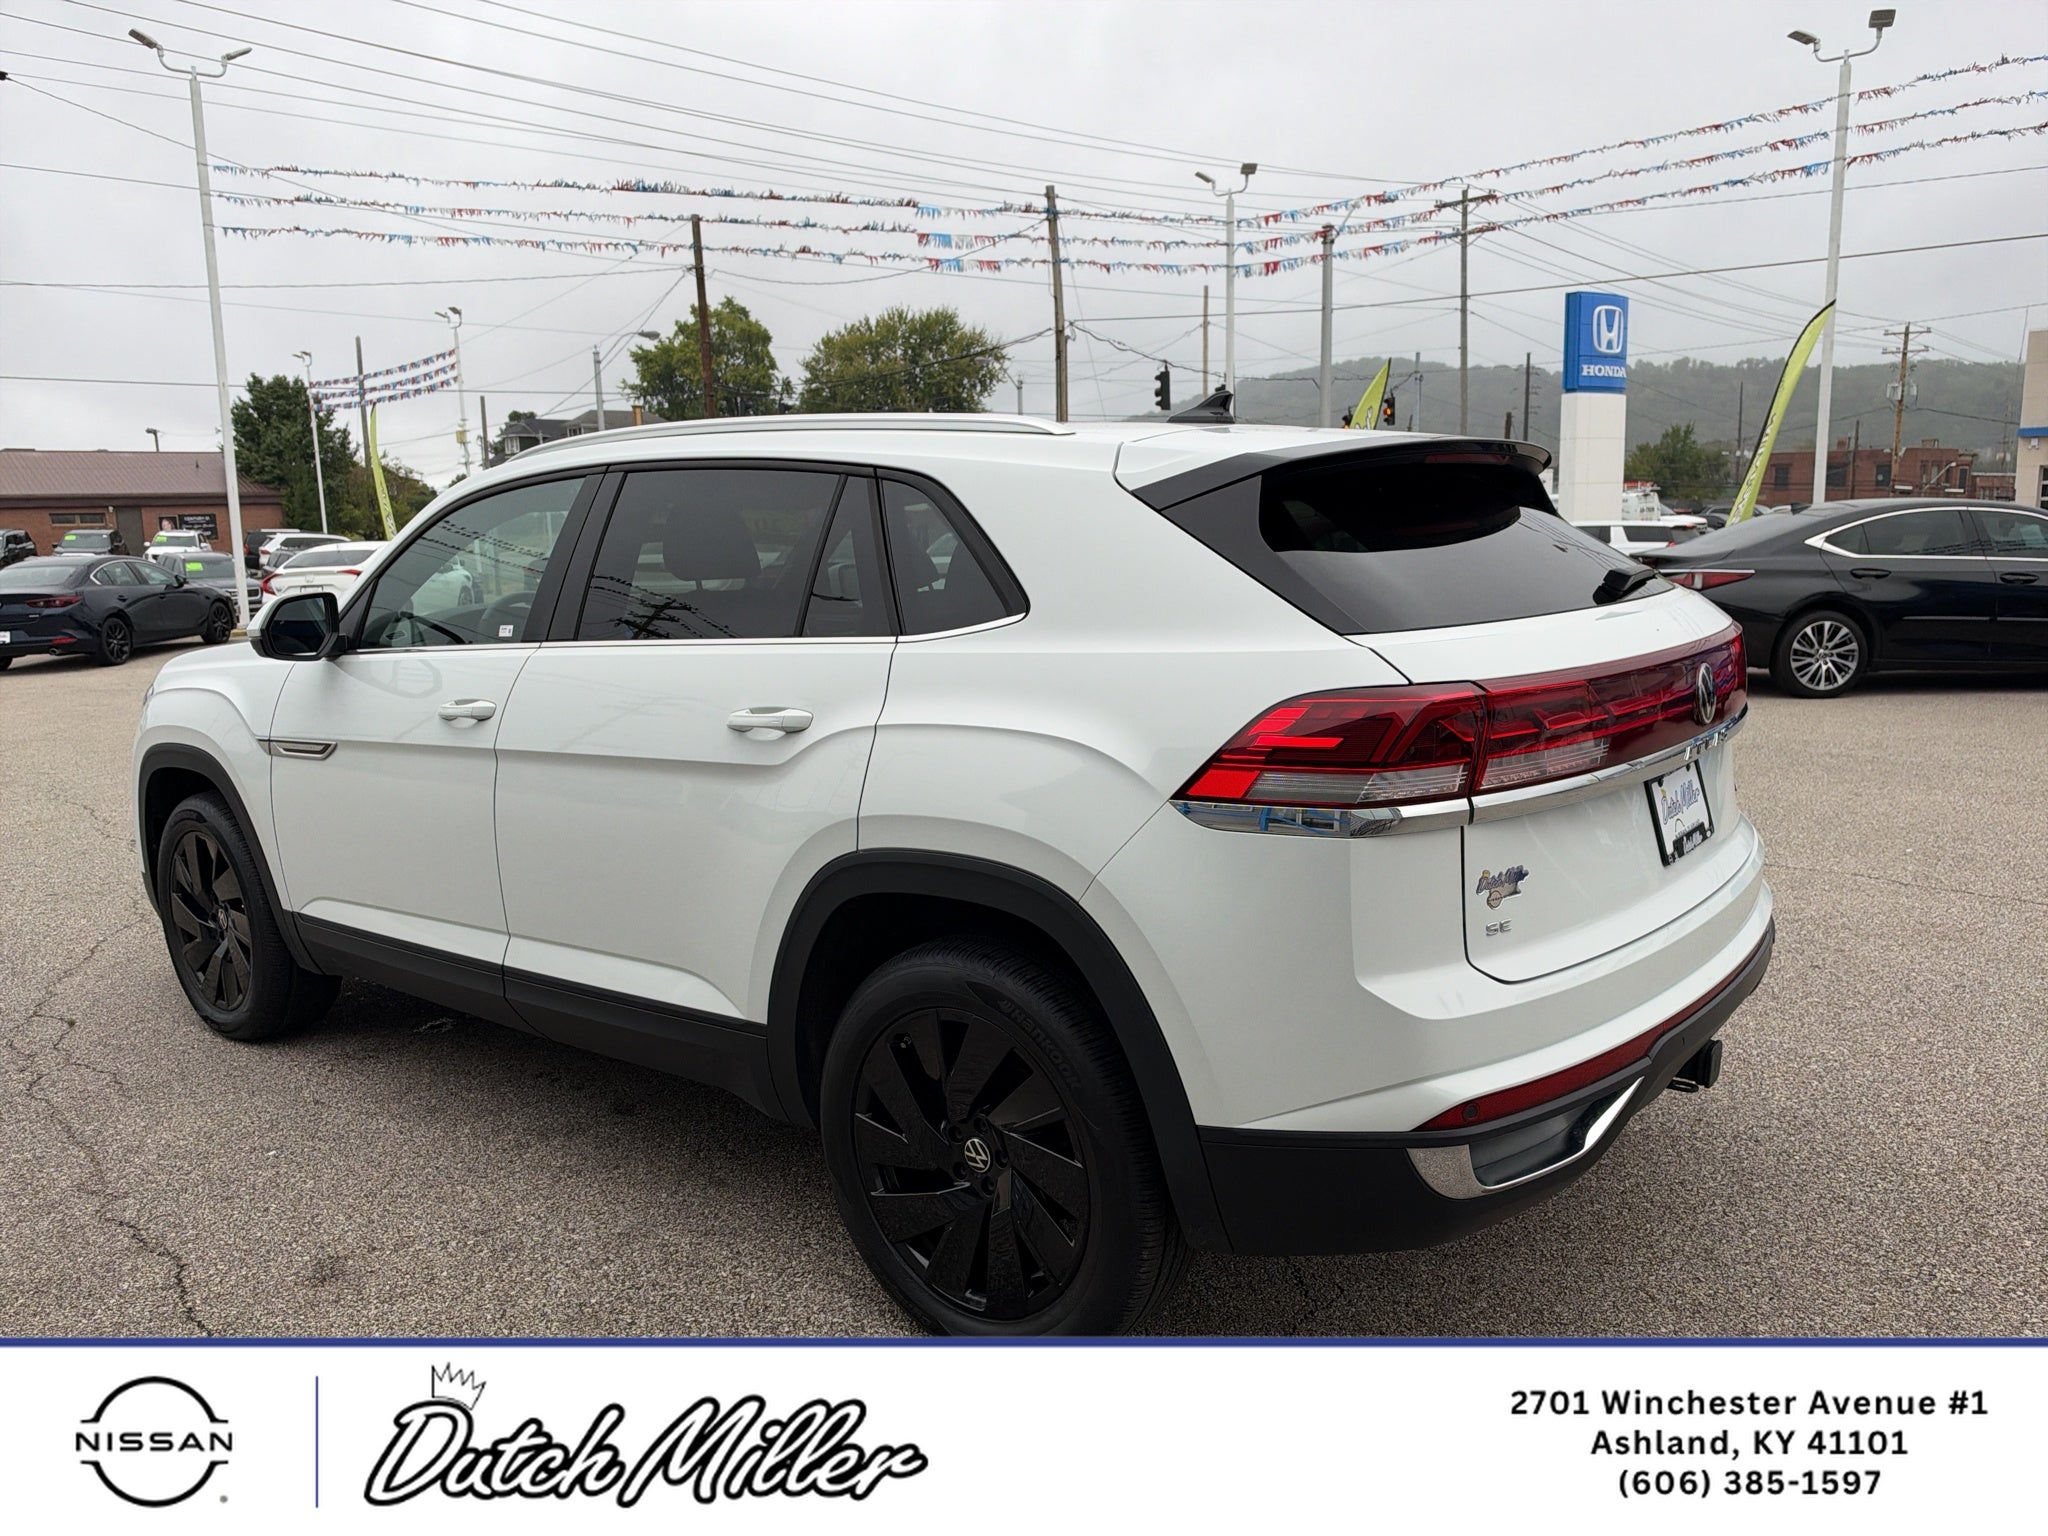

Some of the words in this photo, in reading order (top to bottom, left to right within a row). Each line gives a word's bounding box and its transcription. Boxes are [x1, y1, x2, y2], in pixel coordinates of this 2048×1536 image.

[1581, 364, 1627, 378] HONDA
[1486, 918, 1512, 936] SE
[1009, 1006, 1082, 1090] Hankook
